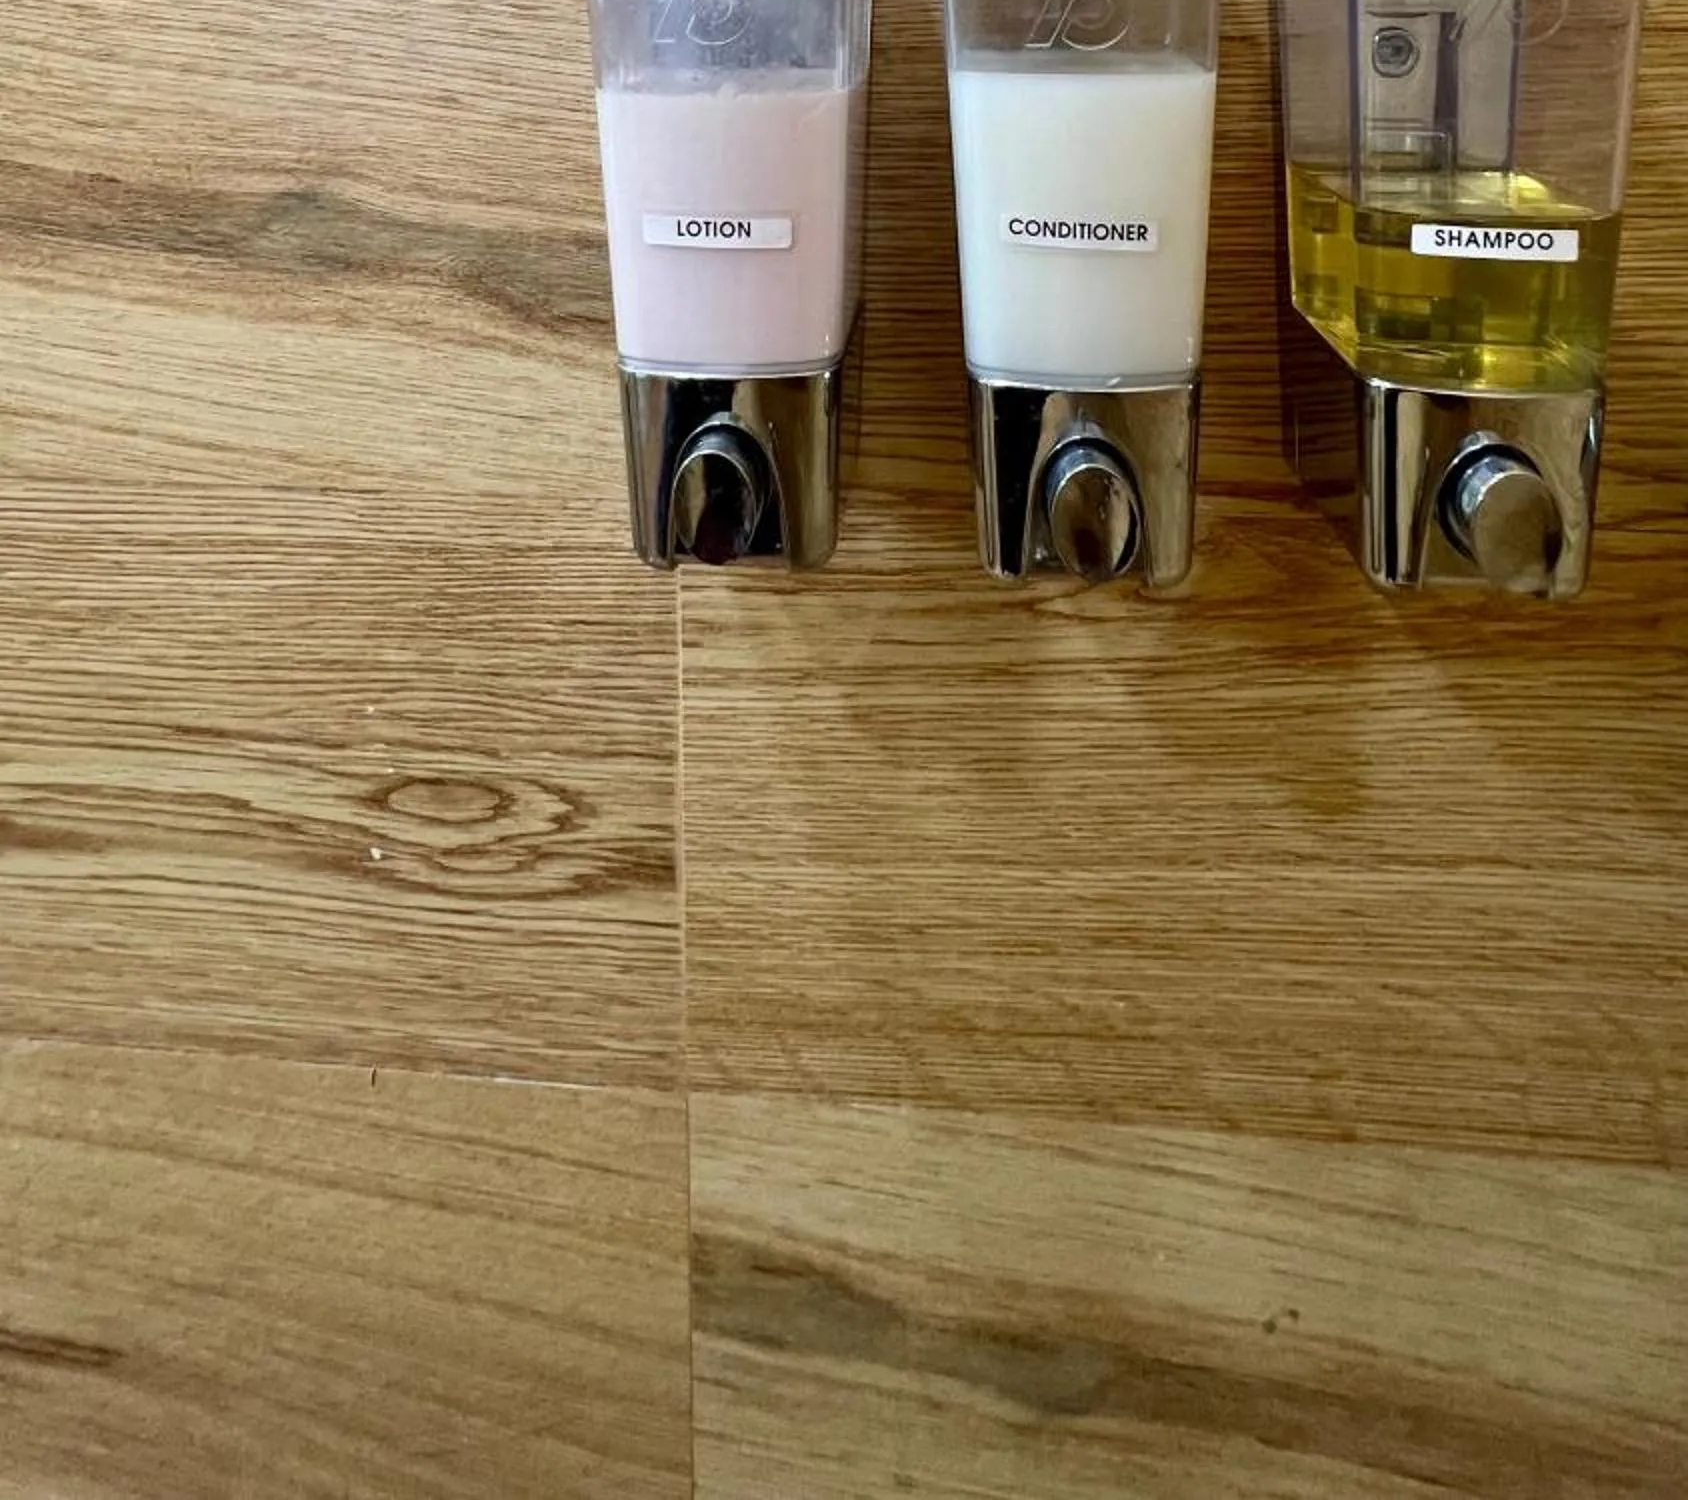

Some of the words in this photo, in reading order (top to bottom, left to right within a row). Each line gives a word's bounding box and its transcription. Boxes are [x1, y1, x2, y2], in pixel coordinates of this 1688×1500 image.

[677, 219, 751, 238] LOTION
[1008, 218, 1149, 241] CONDITIONER
[1434, 229, 1554, 250] SHAMPOO
